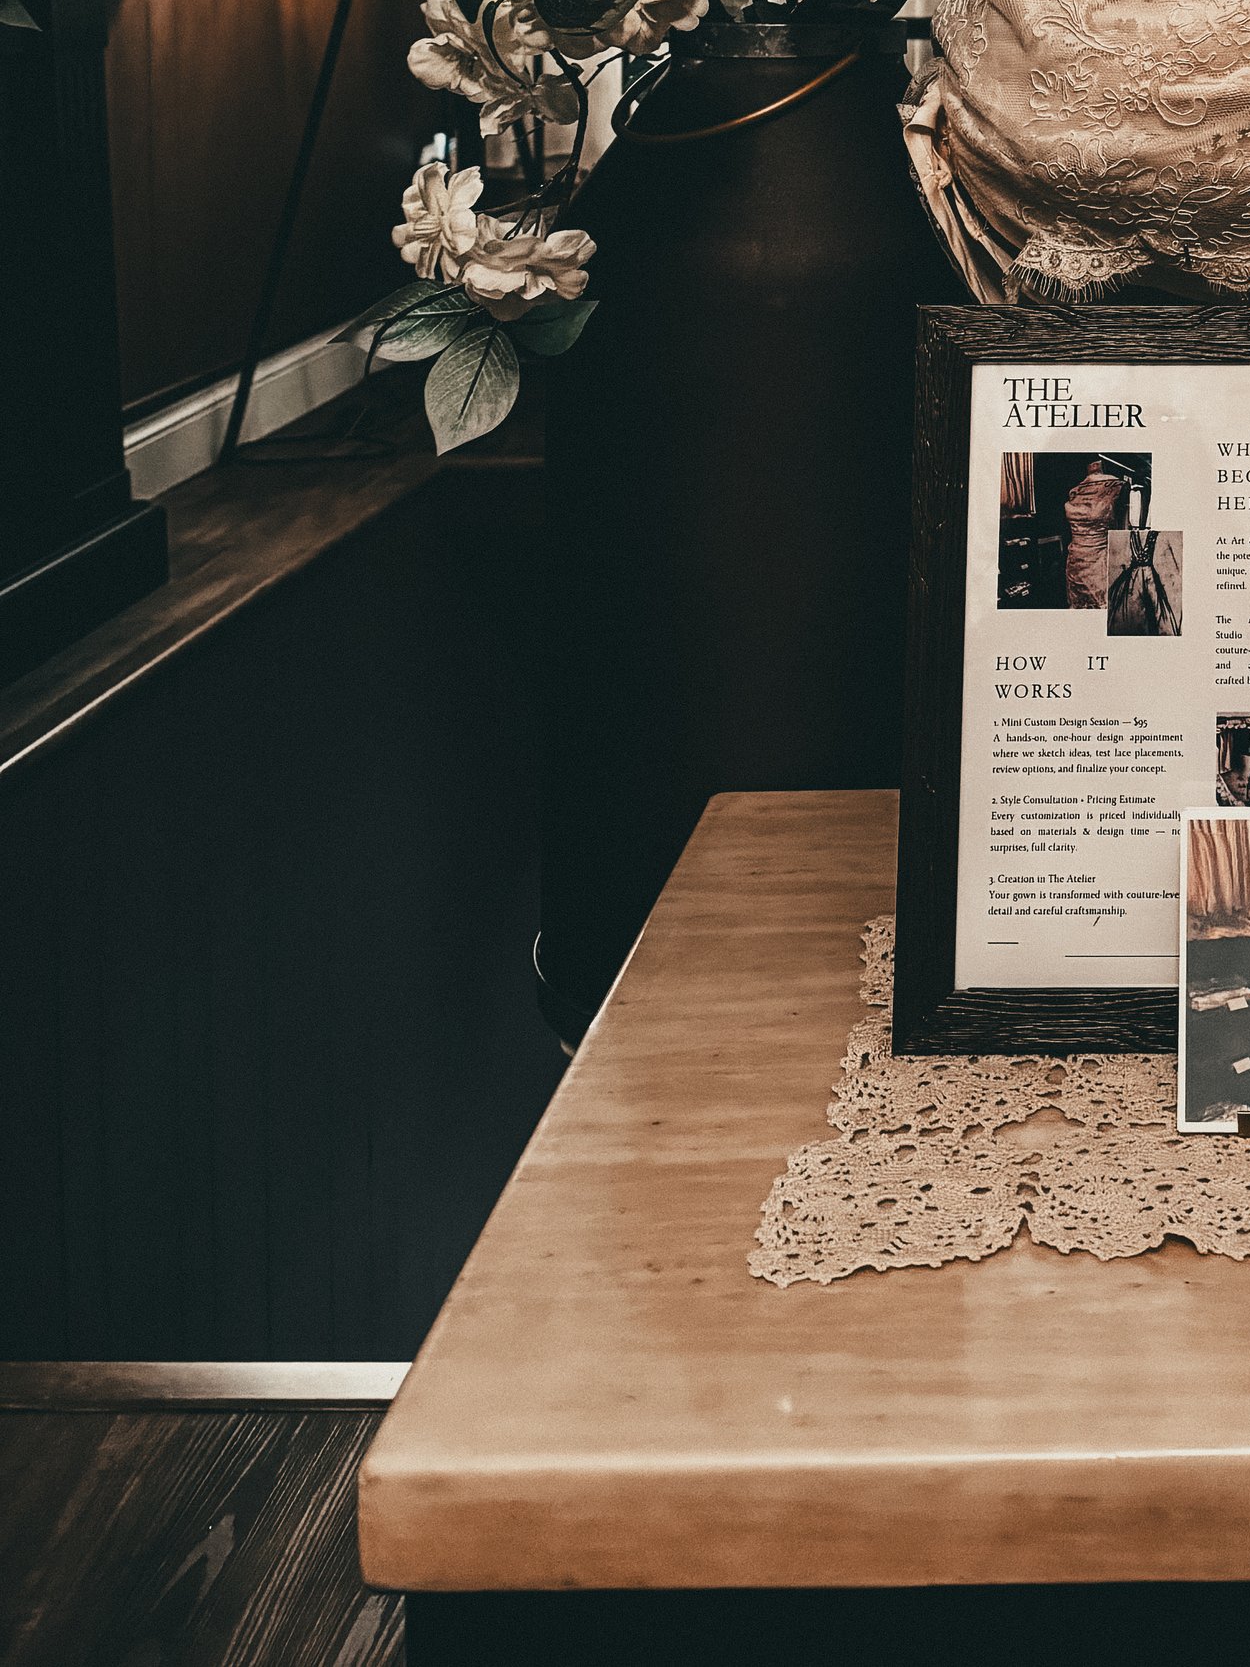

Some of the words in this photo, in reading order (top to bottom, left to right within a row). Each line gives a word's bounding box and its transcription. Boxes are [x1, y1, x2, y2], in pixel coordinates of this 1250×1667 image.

[1002, 377, 1074, 402] THE
[1001, 402, 1147, 428] ATELIER
[1215, 536, 1228, 546] At
[1230, 536, 1245, 546] Art
[1216, 550, 1231, 560] the
[1216, 566, 1248, 578] unique,
[1216, 580, 1248, 590] refined.
[1215, 614, 1232, 625] The
[1215, 630, 1243, 640] Studio
[995, 655, 1047, 671] HOW
[1087, 655, 1109, 671] IT
[1214, 659, 1232, 670] and
[1214, 675, 1245, 686] crafted
[994, 683, 1072, 700] WORKS
[1001, 717, 1022, 728] Mini
[1023, 717, 1057, 727] Custom
[1058, 717, 1088, 729] Design
[1089, 716, 1120, 727] Session
[1133, 716, 1148, 729] $95
[992, 733, 1001, 743] A
[1052, 732, 1093, 743] one-hour
[1096, 731, 1124, 745] design
[1129, 733, 1184, 745] appointment
[992, 748, 1020, 759] where
[1021, 750, 1035, 758] we
[1037, 747, 1066, 758] sketch
[1066, 747, 1093, 759] ideas,
[1095, 749, 1111, 758] test
[1114, 747, 1132, 758] lace
[1134, 747, 1184, 760] placements,
[992, 764, 1021, 774] review
[1021, 765, 1057, 777] options,
[1057, 763, 1074, 774] and
[1075, 762, 1108, 774] finalize
[1108, 765, 1130, 776] your
[1130, 765, 1167, 776] concept.
[991, 797, 999, 805] 2.
[999, 795, 1022, 808] Style
[1022, 794, 1079, 805] Consultation
[1086, 794, 1118, 807] Pricing
[1119, 794, 1156, 805] Estimate
[991, 810, 1016, 823] Every
[1020, 811, 1081, 821] customization
[1086, 811, 1094, 820] is
[1099, 809, 1126, 823] priced
[990, 826, 1015, 837] based
[1019, 828, 1032, 837] on
[1037, 825, 1077, 836] materials
[1082, 827, 1091, 836] &
[1096, 825, 1125, 839] design
[1130, 826, 1150, 836] time
[989, 843, 1030, 855] surprises,
[1031, 842, 1046, 852] full
[1047, 842, 1078, 854] clarity.
[988, 876, 996, 886] 3.
[997, 873, 1035, 884] Creation
[1036, 875, 1046, 884] in
[1047, 873, 1065, 884] The
[1065, 873, 1097, 884] Atelier
[988, 889, 1011, 900] Your
[1012, 892, 1037, 903] gown
[1039, 890, 1047, 900] is
[1048, 889, 1101, 900] transformed
[1103, 889, 1124, 900] with
[987, 905, 1013, 916] detail
[1014, 905, 1031, 916] and
[1032, 905, 1064, 916] careful
[1064, 905, 1128, 919] craftsmanship.
